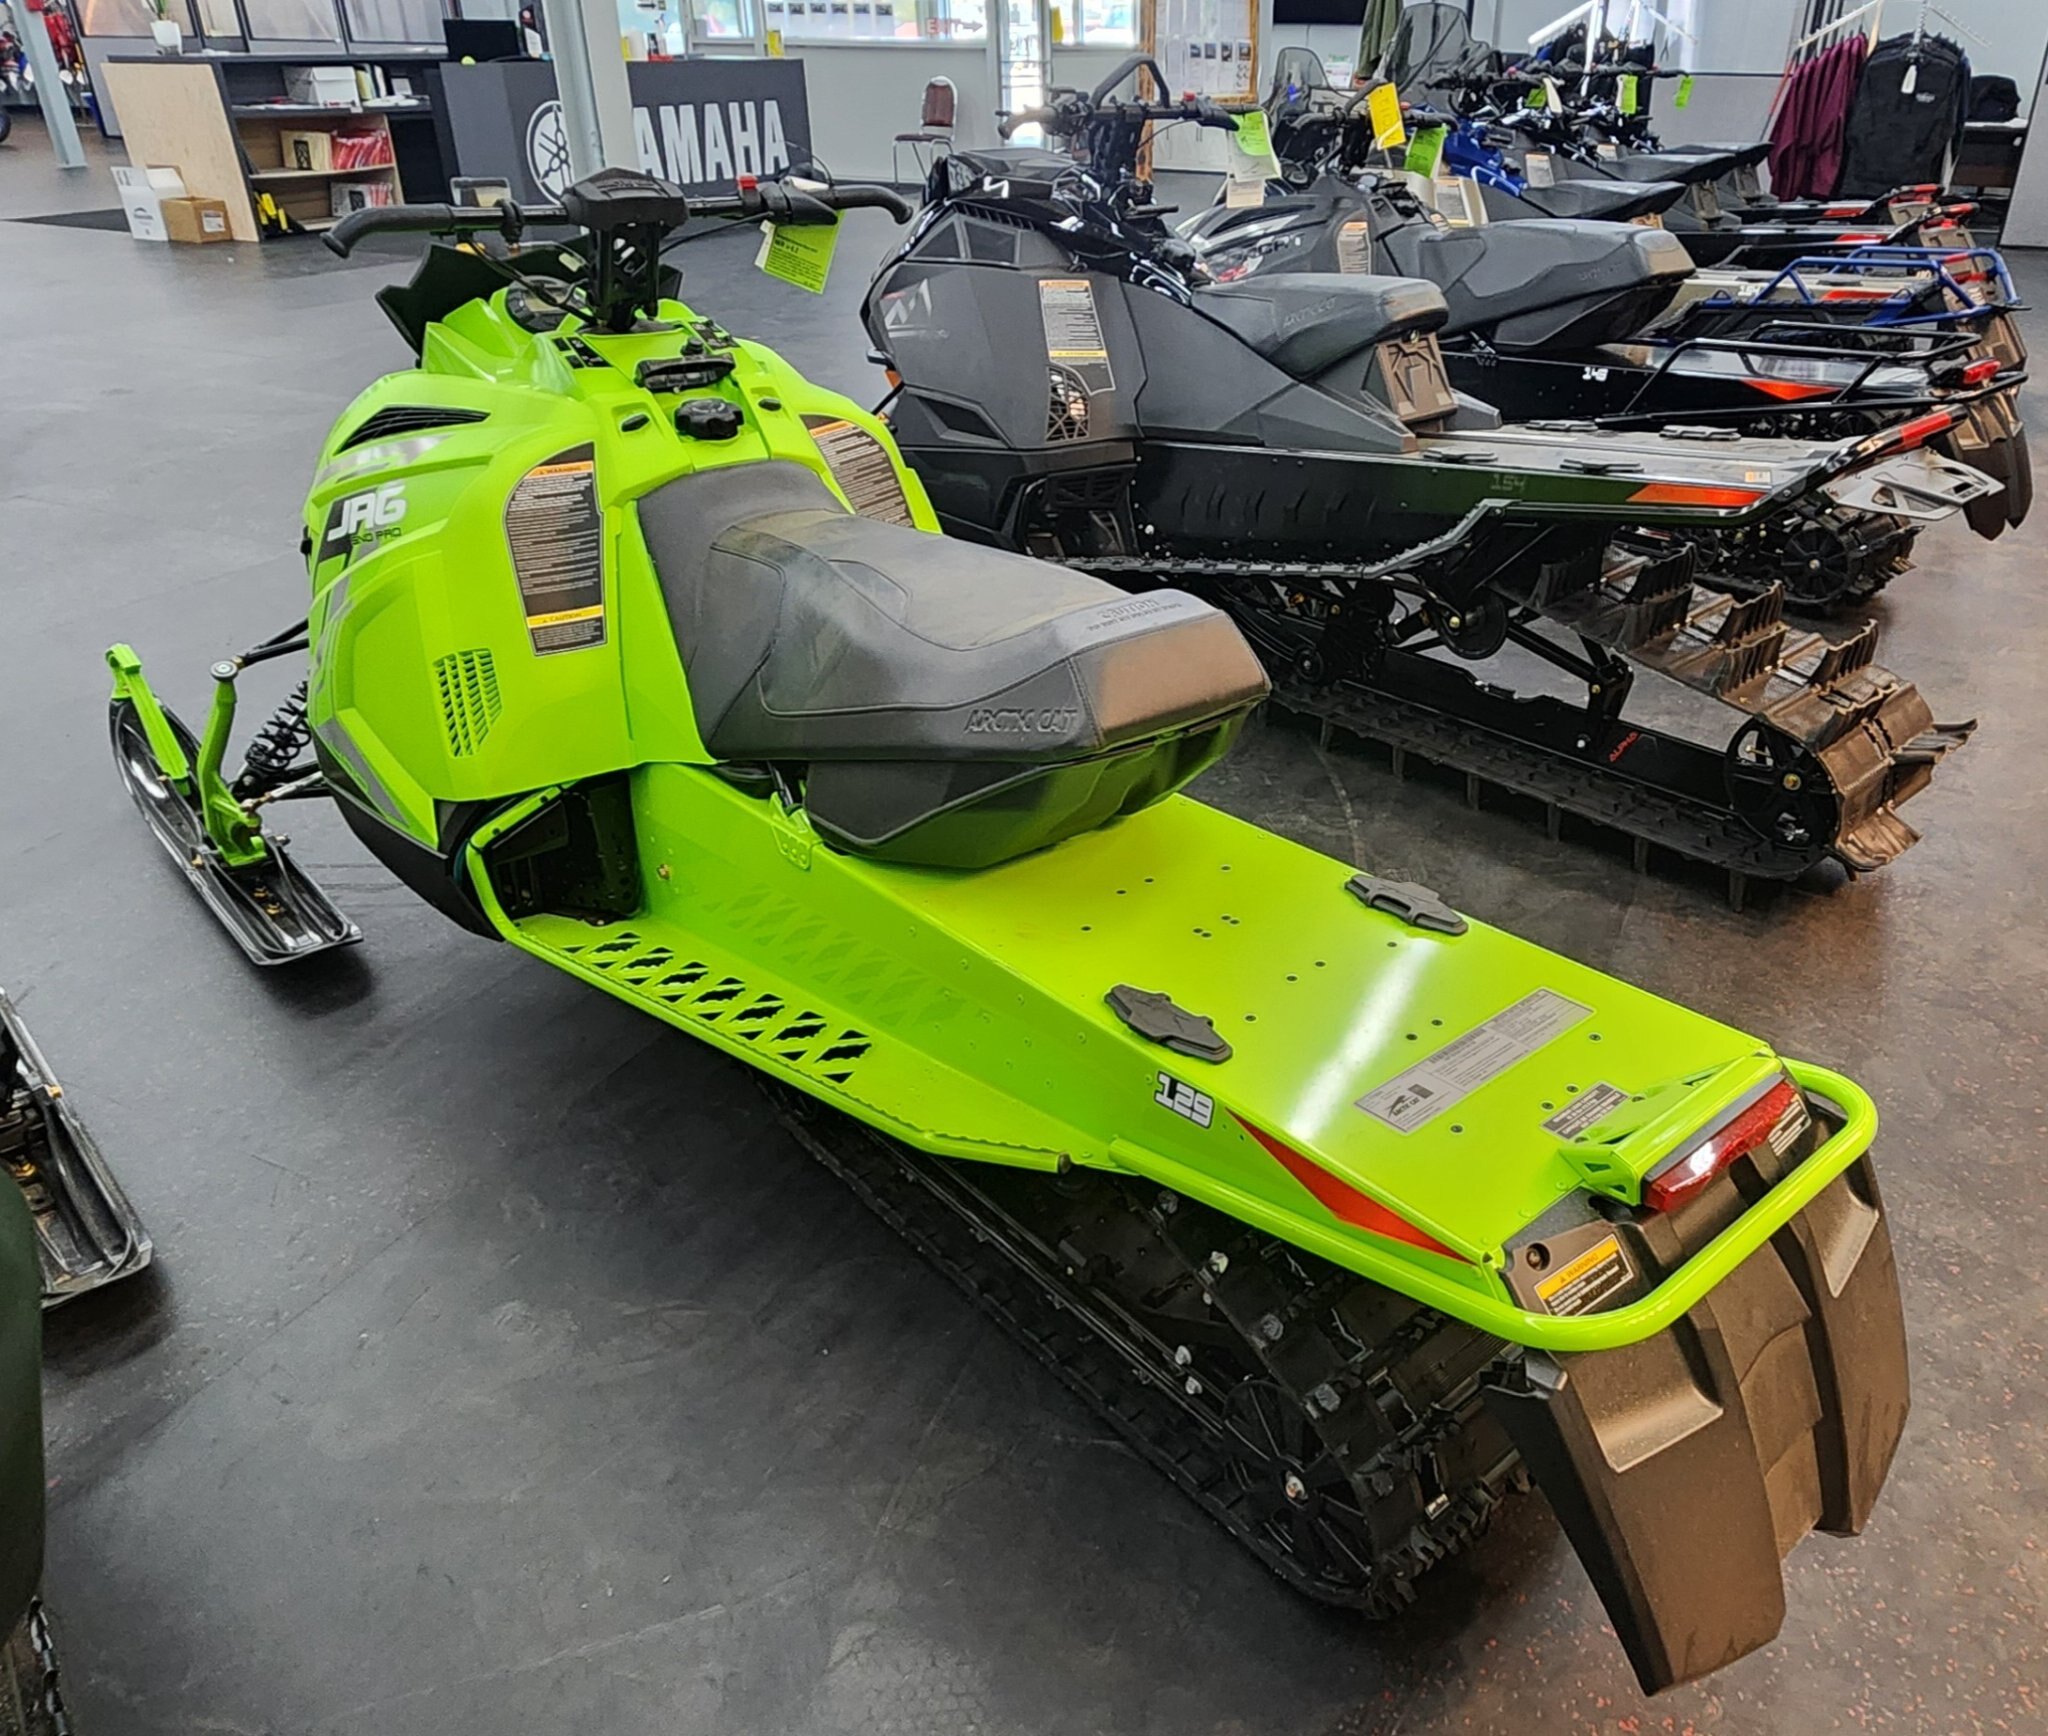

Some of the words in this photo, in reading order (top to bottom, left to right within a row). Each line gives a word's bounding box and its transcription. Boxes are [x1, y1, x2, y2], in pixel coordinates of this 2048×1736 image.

[633, 100, 790, 184] AMAHA
[964, 708, 1035, 733] ARCTIC
[1037, 708, 1077, 733] CAT
[1154, 1071, 1214, 1129] 129
